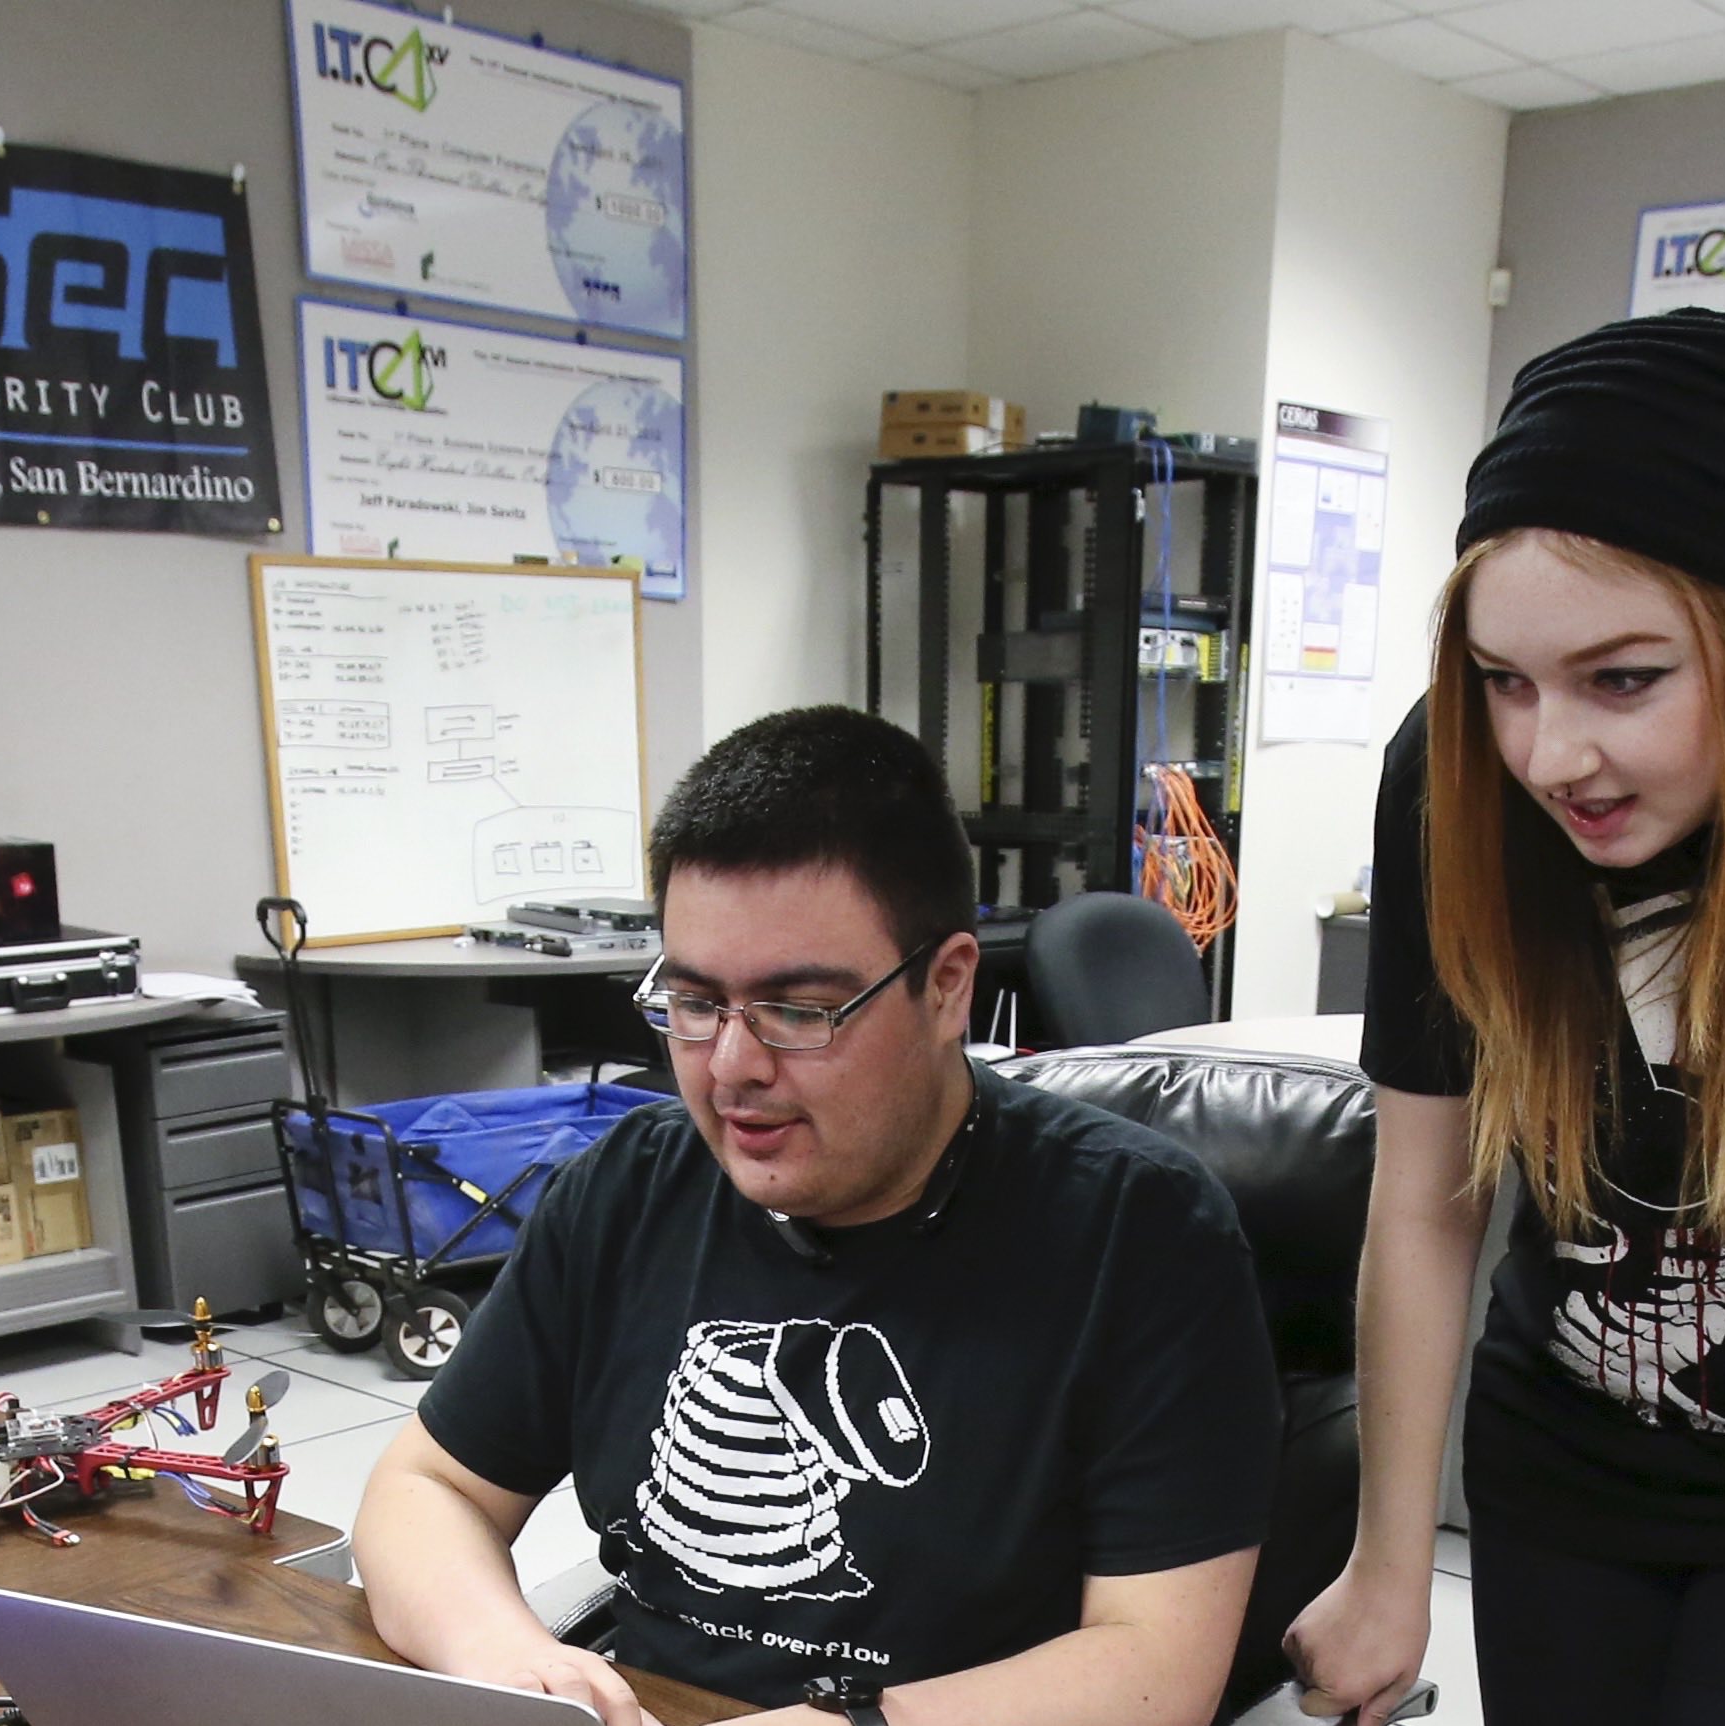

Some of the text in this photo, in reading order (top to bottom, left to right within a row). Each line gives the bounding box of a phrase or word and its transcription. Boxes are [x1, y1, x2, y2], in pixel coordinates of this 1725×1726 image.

[141, 379, 245, 430] CLUB
[10, 458, 70, 497] San
[77, 461, 256, 507] Bernardino
[761, 1632, 891, 1666] overflow
